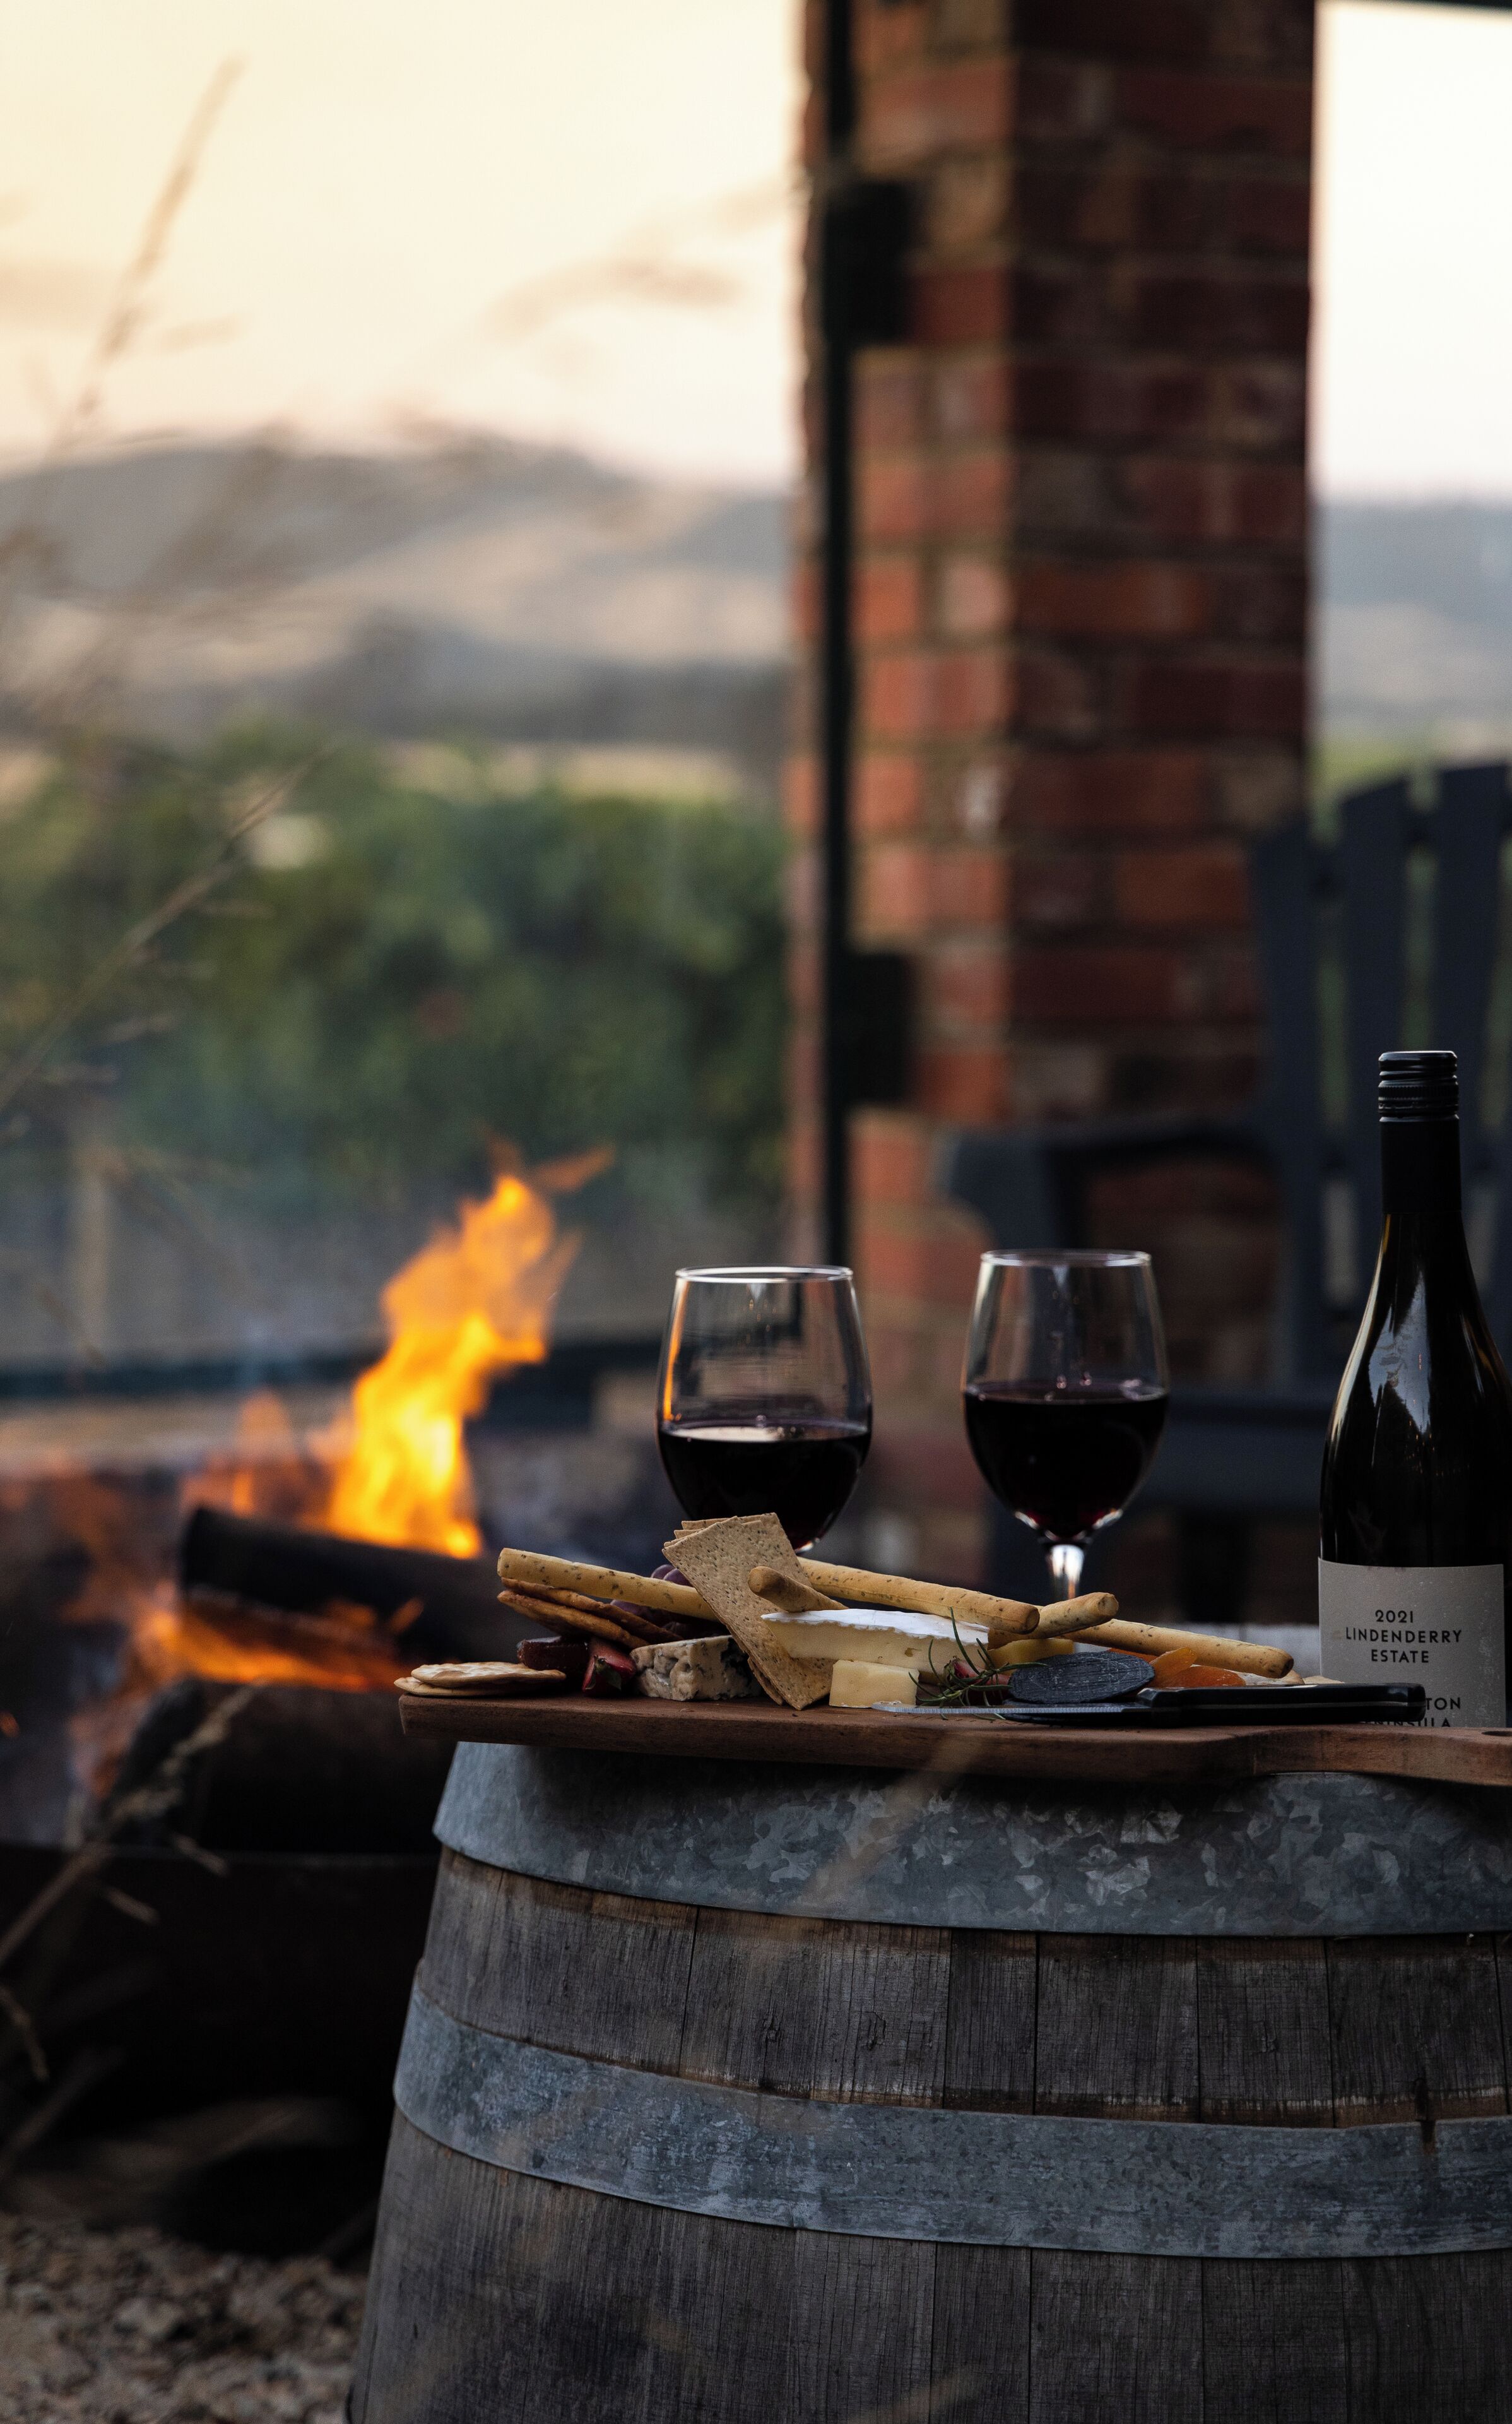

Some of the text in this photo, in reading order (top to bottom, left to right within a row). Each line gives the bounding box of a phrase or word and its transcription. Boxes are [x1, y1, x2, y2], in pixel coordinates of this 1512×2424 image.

[1375, 1610, 1414, 1623] 2021
[1346, 1627, 1462, 1643] LINDENDERRY
[1371, 1649, 1429, 1663] ESTATE
[1426, 1697, 1461, 1710] TON
